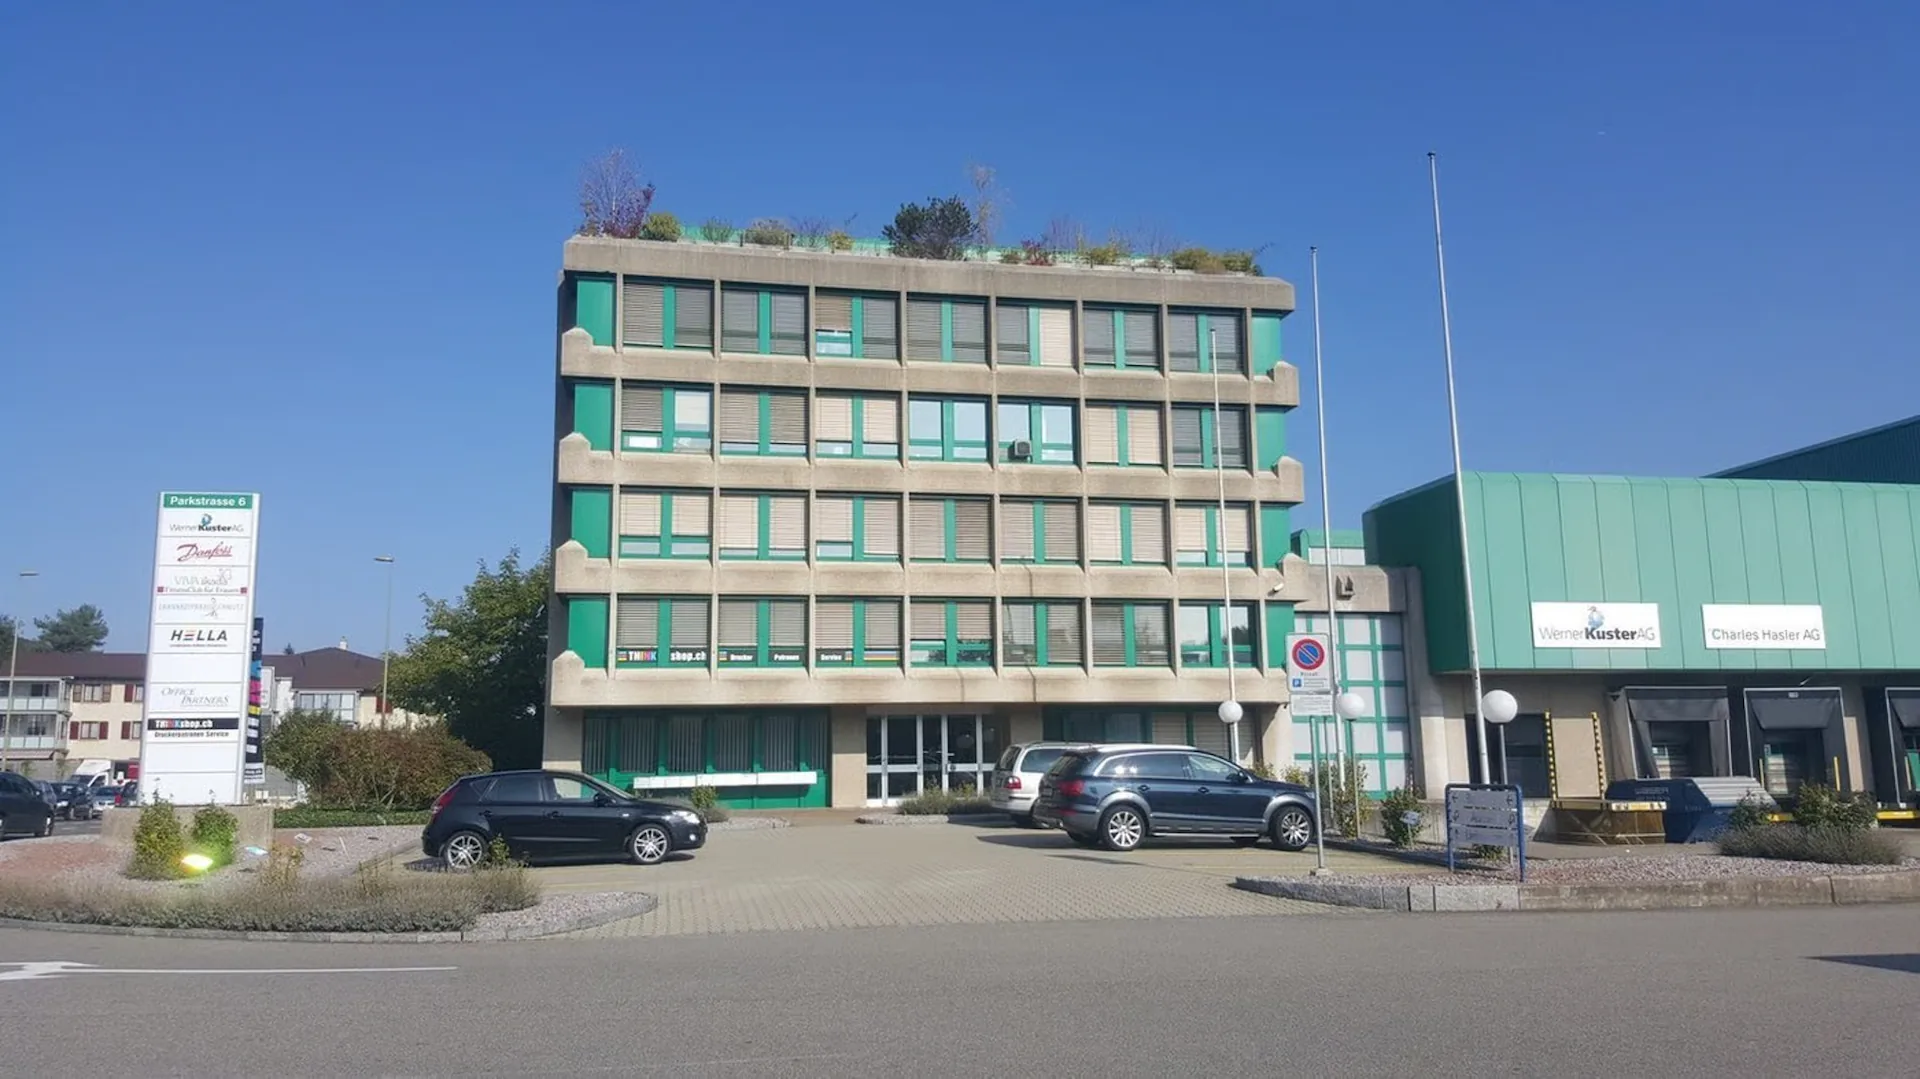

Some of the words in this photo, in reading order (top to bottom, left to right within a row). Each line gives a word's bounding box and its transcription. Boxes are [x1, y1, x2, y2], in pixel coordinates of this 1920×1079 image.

[170, 495, 236, 506] Parkstrasse
[238, 496, 247, 506] 6
[170, 629, 228, 641] HELLA
[1711, 627, 1760, 641] Charles
[1761, 628, 1801, 641] Hasler
[1803, 627, 1821, 641] AG
[628, 650, 657, 661] THINK
[670, 650, 707, 662] shop.ch
